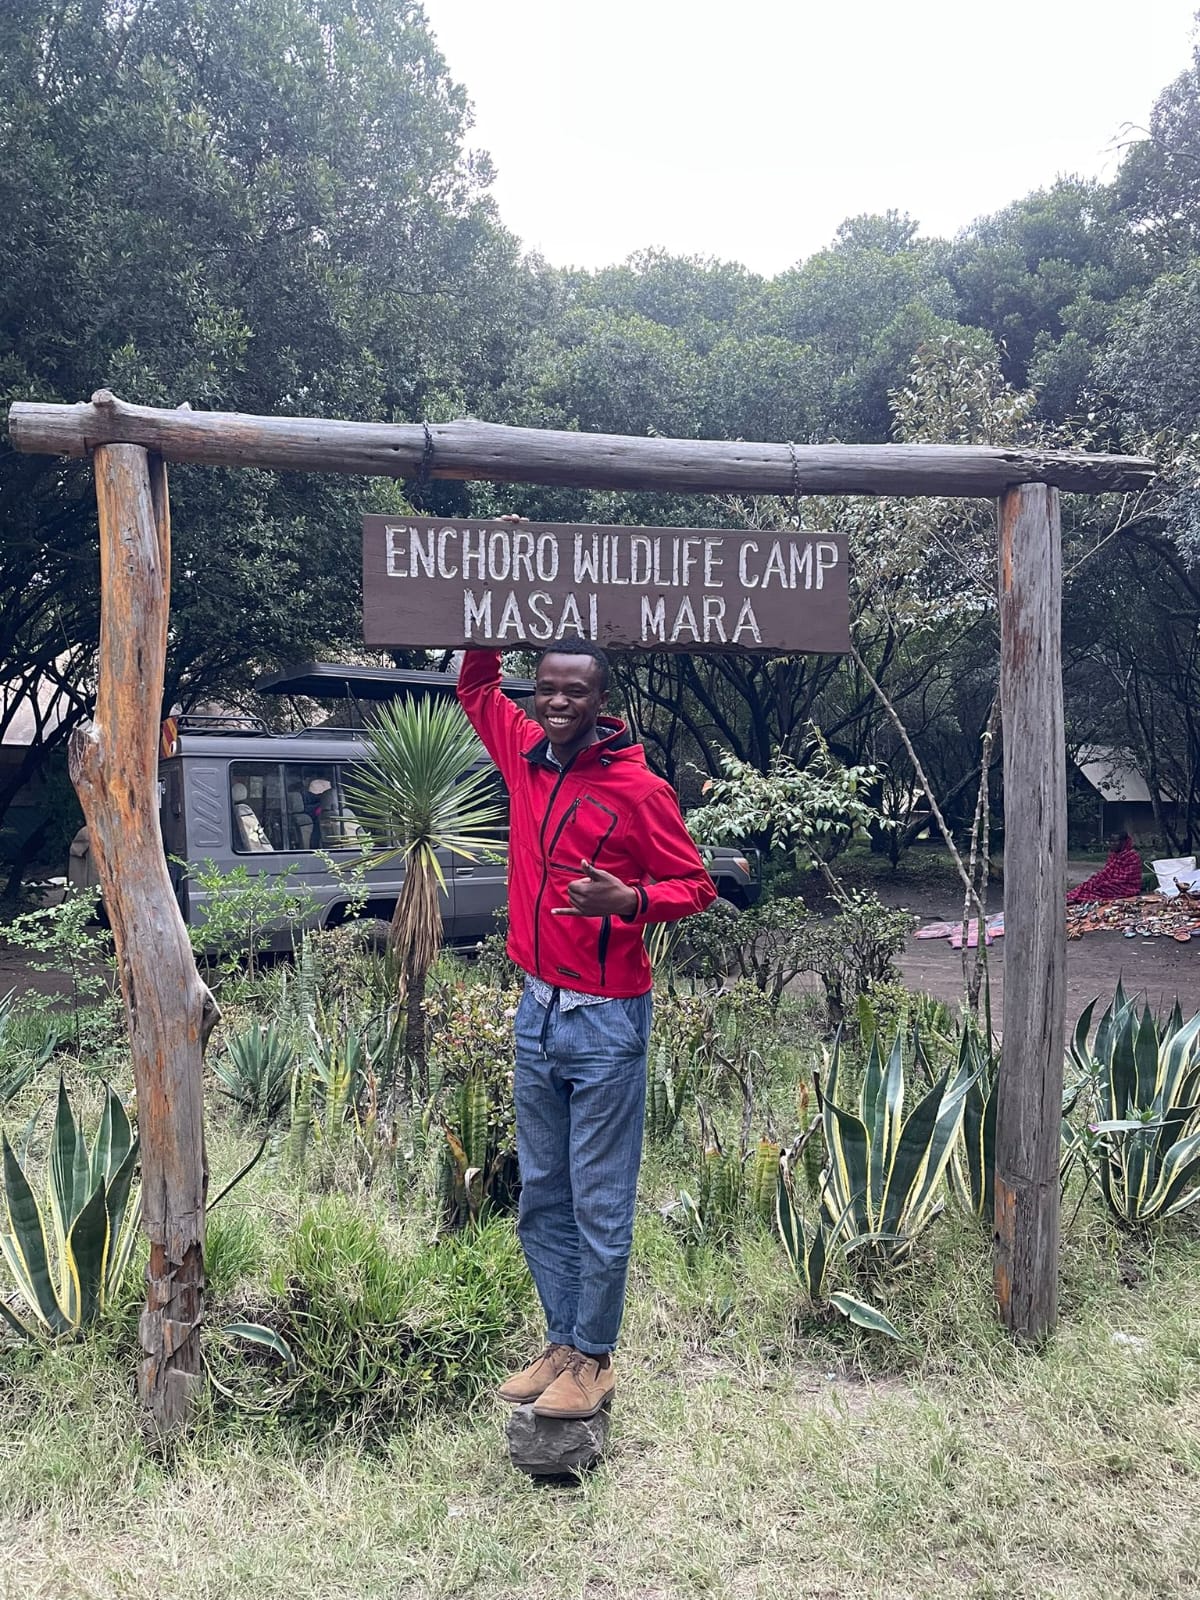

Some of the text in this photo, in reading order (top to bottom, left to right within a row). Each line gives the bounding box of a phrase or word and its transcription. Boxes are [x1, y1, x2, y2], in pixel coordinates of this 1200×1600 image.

[385, 524, 839, 590] ENCHORO WILDLIFE CAMP
[463, 588, 763, 643] MASAI MARA
